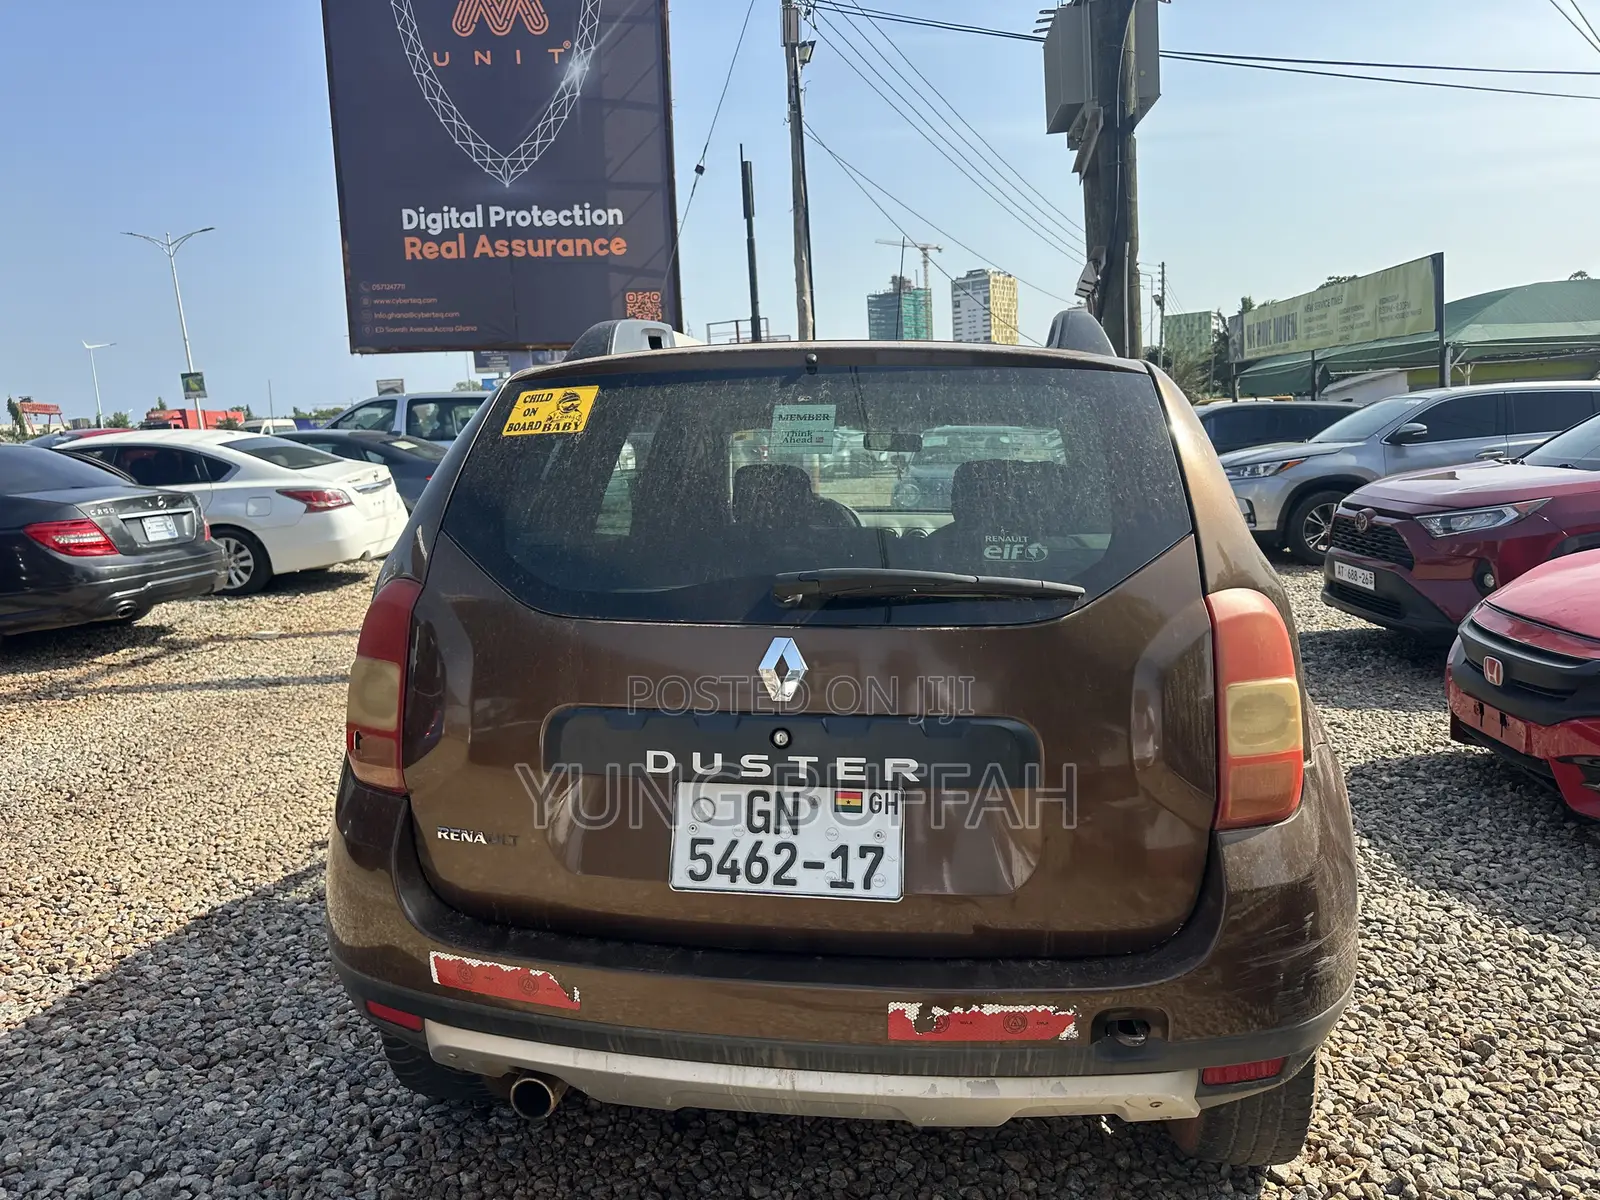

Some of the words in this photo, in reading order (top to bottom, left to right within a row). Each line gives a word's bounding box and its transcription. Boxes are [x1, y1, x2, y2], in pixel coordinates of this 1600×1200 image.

[402, 204, 484, 235] Digital
[489, 202, 624, 228] Protection
[404, 233, 466, 260] Real
[474, 234, 628, 258] Assurance
[523, 392, 554, 404] CHILD
[523, 407, 539, 417] ON
[778, 413, 830, 421] MEMBER
[506, 421, 542, 432] BOARD
[542, 422, 581, 432] BABY
[985, 535, 1028, 543] RENAULT
[646, 750, 921, 782] DUSTER
[746, 789, 800, 835] GN
[868, 791, 898, 815] GH
[688, 837, 885, 890] 5462-17
